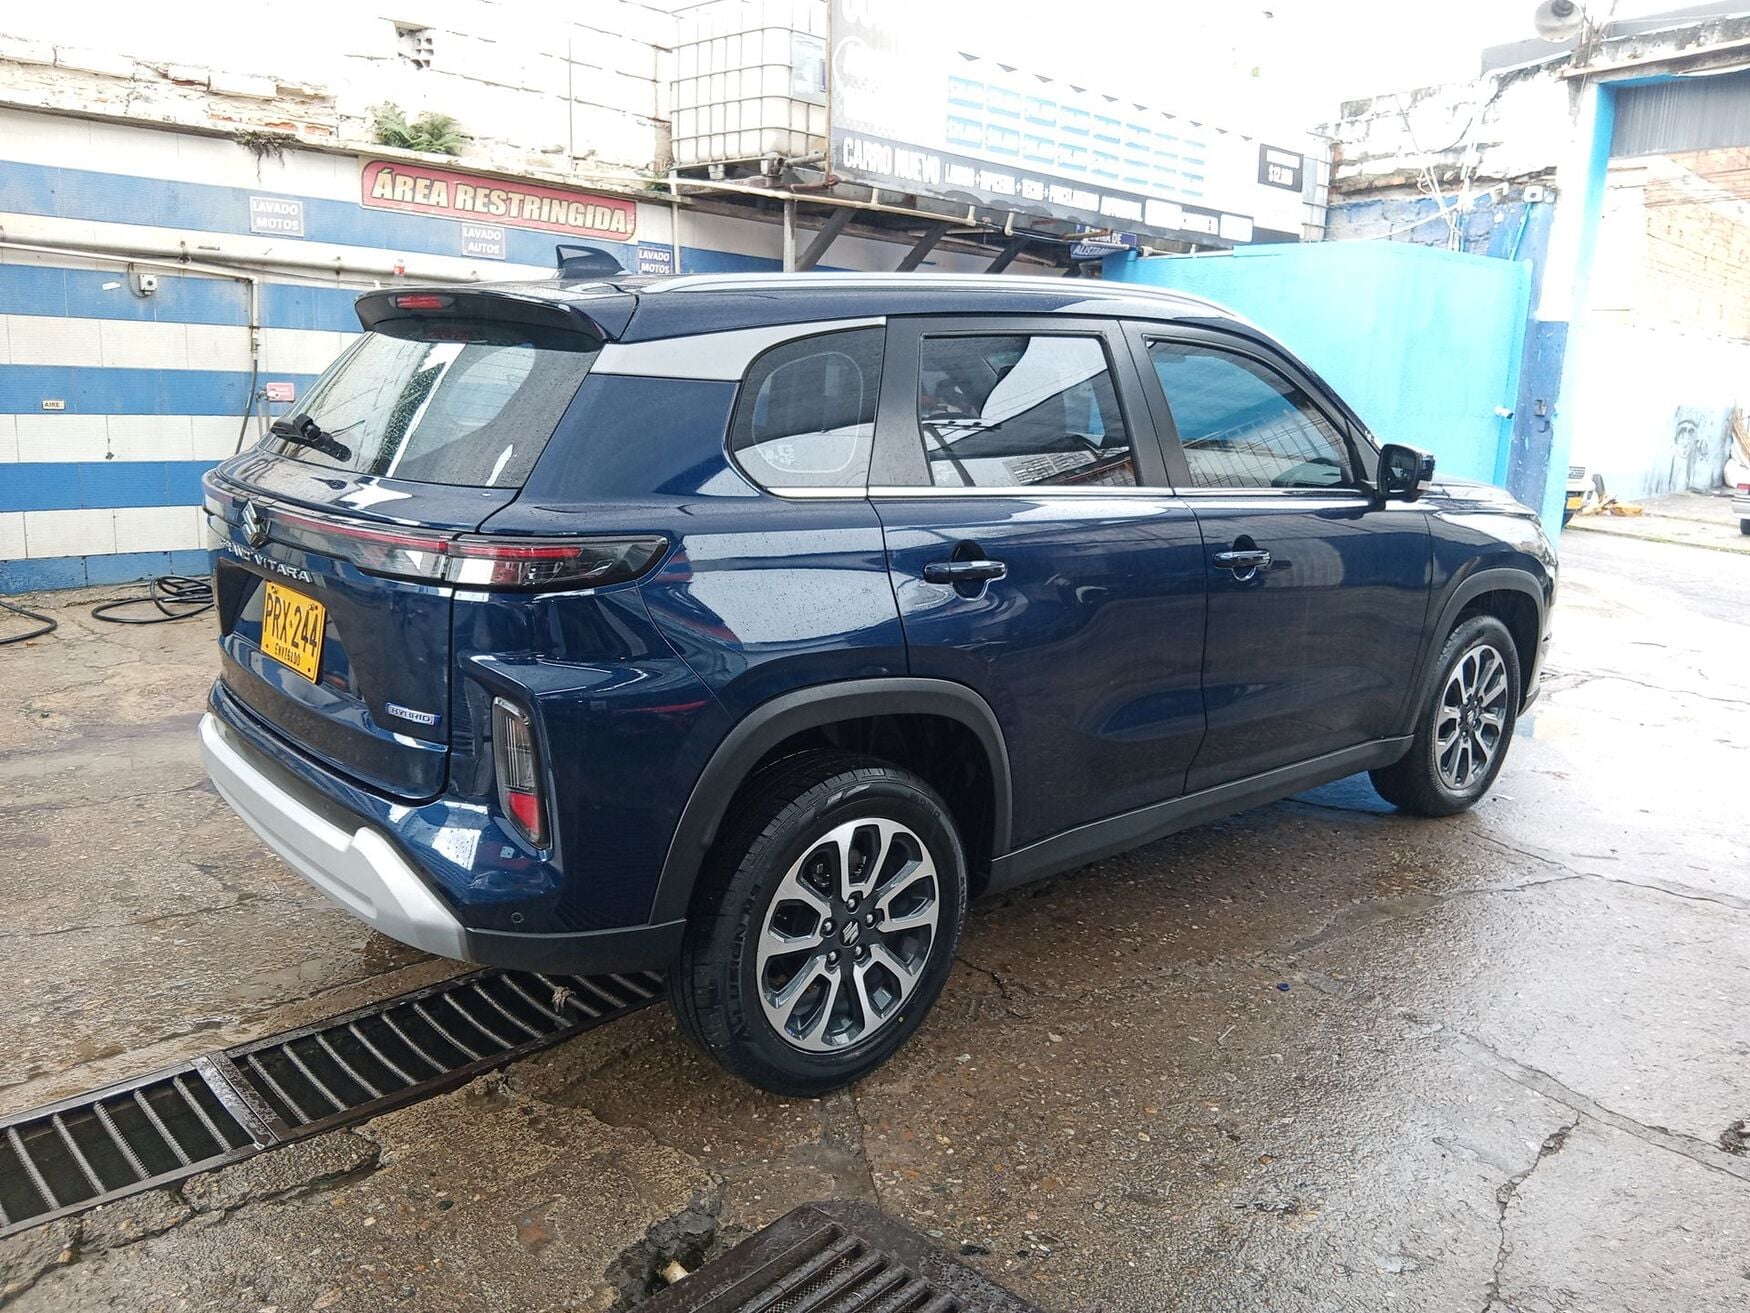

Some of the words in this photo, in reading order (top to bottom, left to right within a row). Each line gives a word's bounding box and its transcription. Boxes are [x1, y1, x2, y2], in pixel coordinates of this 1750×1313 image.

[842, 136, 893, 176] CARRO
[893, 147, 941, 186] NUEVO
[252, 200, 299, 216] LAVADO
[370, 166, 449, 208] ÁREA
[454, 182, 628, 235] RESTRINGIDA
[256, 217, 299, 231] MOTOS
[464, 227, 502, 241] LAVADO
[467, 242, 500, 255] AUTOS
[640, 250, 670, 262] LAVADO
[641, 262, 670, 274] MOTOS
[254, 553, 314, 583] VITARA
[390, 705, 432, 723] HYBRID
